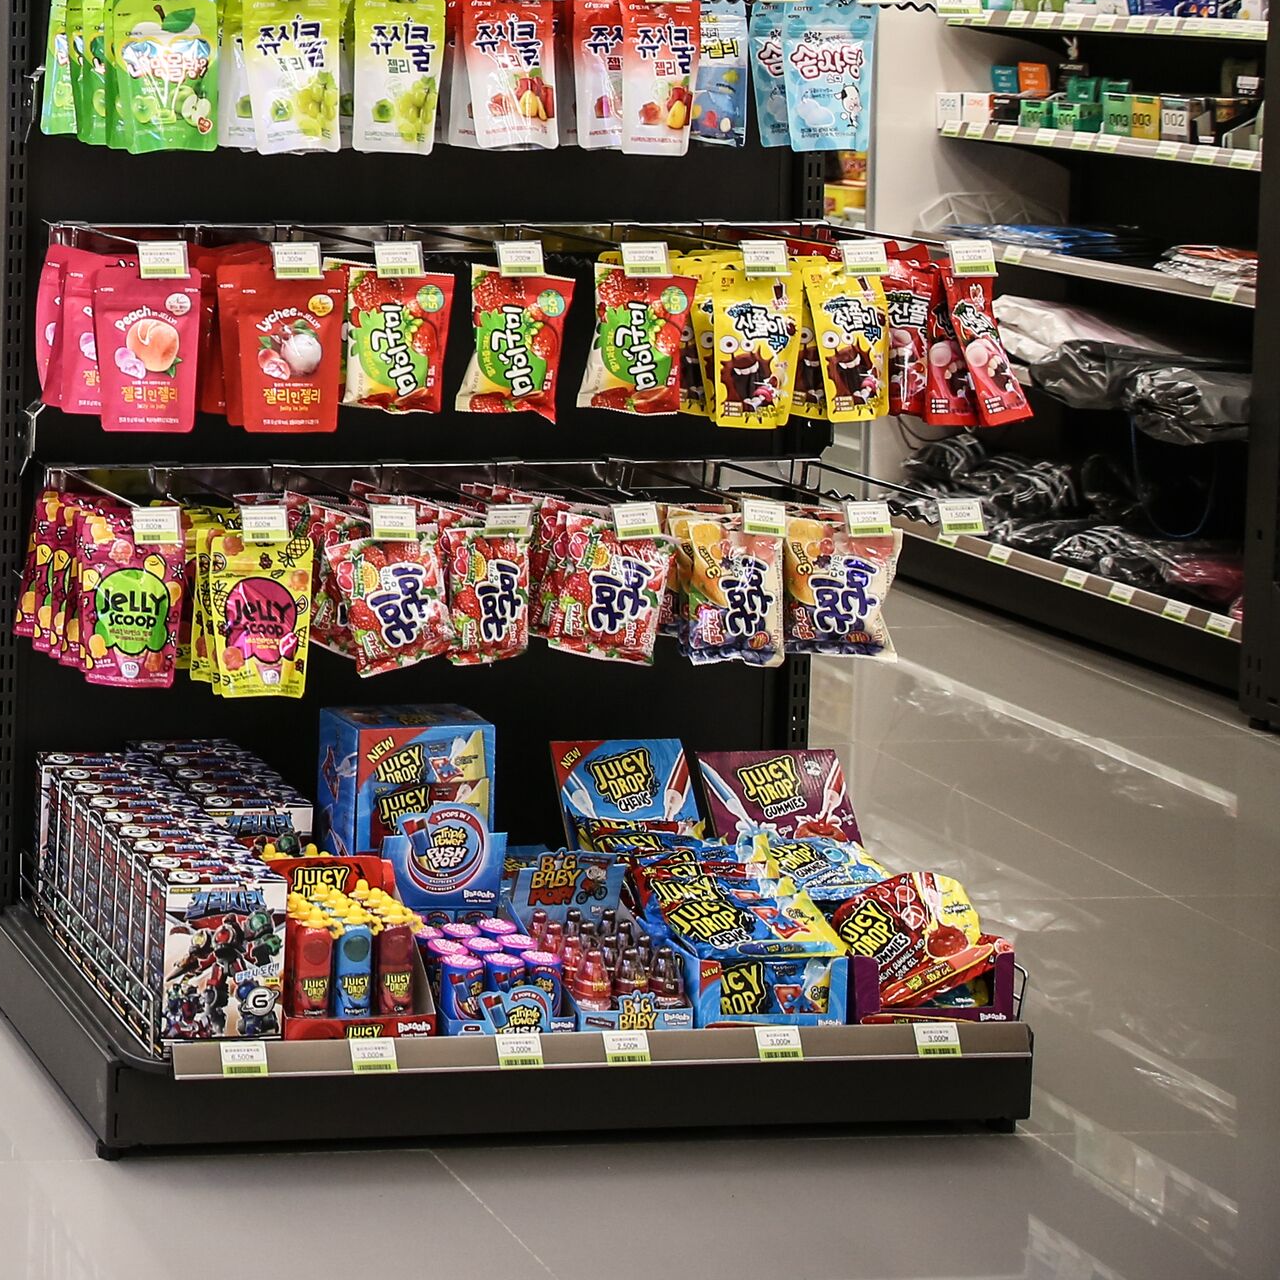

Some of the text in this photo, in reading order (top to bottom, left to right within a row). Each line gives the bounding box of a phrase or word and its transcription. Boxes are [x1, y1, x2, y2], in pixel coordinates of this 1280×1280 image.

[371, 19, 435, 73] 쥬시쿨
[474, 20, 541, 67] 쥬시쿨
[637, 23, 695, 75] 쥬시쿨
[387, 58, 411, 74] 젤리
[654, 61, 676, 76] 젤리
[790, 44, 864, 80] 솜사탕
[1163, 112, 1184, 127] 002
[114, 305, 153, 332] Peach
[256, 307, 298, 333] Lychee
[371, 303, 418, 397] 마이구미
[491, 304, 535, 397] 마이구미
[615, 301, 656, 392] 마이구미
[120, 386, 178, 403] 젤리인젤리
[263, 388, 321, 405] 젤리인젤리
[392, 566, 428, 618] 구미
[496, 562, 521, 619] 구미
[620, 558, 652, 617] 구미
[746, 558, 775, 615] 구미
[842, 558, 880, 616] 구미
[477, 585, 508, 641] 구미
[589, 575, 625, 633] 구미
[721, 580, 753, 636] 구미
[811, 577, 852, 633] 구미
[370, 593, 418, 646] 구미
[367, 736, 396, 763] NEW
[560, 746, 582, 769] NEW
[377, 745, 423, 782] JUICY
[594, 752, 650, 791] JUICY
[739, 756, 796, 796] JUICY
[608, 772, 646, 799] DROP
[756, 779, 794, 808] DROP
[381, 787, 428, 820] JUICY
[618, 795, 652, 812] CHEWS
[765, 797, 806, 818] GUMMIES
[430, 825, 467, 840] Triple
[434, 835, 465, 847] Power
[426, 846, 468, 860] PUSH
[432, 856, 462, 868] POP
[541, 854, 576, 871] BIG
[296, 869, 346, 892] JUICY
[531, 869, 582, 891] BABY
[692, 912, 735, 937] DROP
[712, 930, 750, 947] CHEWS
[852, 921, 894, 957] DROP
[303, 977, 328, 989] JUICY
[343, 976, 369, 989] JUICY
[384, 974, 411, 987] JUICY
[701, 967, 719, 978] NEW
[508, 1006, 540, 1017] Triple
[623, 996, 652, 1015] BIG
[347, 1024, 382, 1038] JUICY
[509, 1014, 539, 1025] Power
[619, 1013, 658, 1030] BABY
